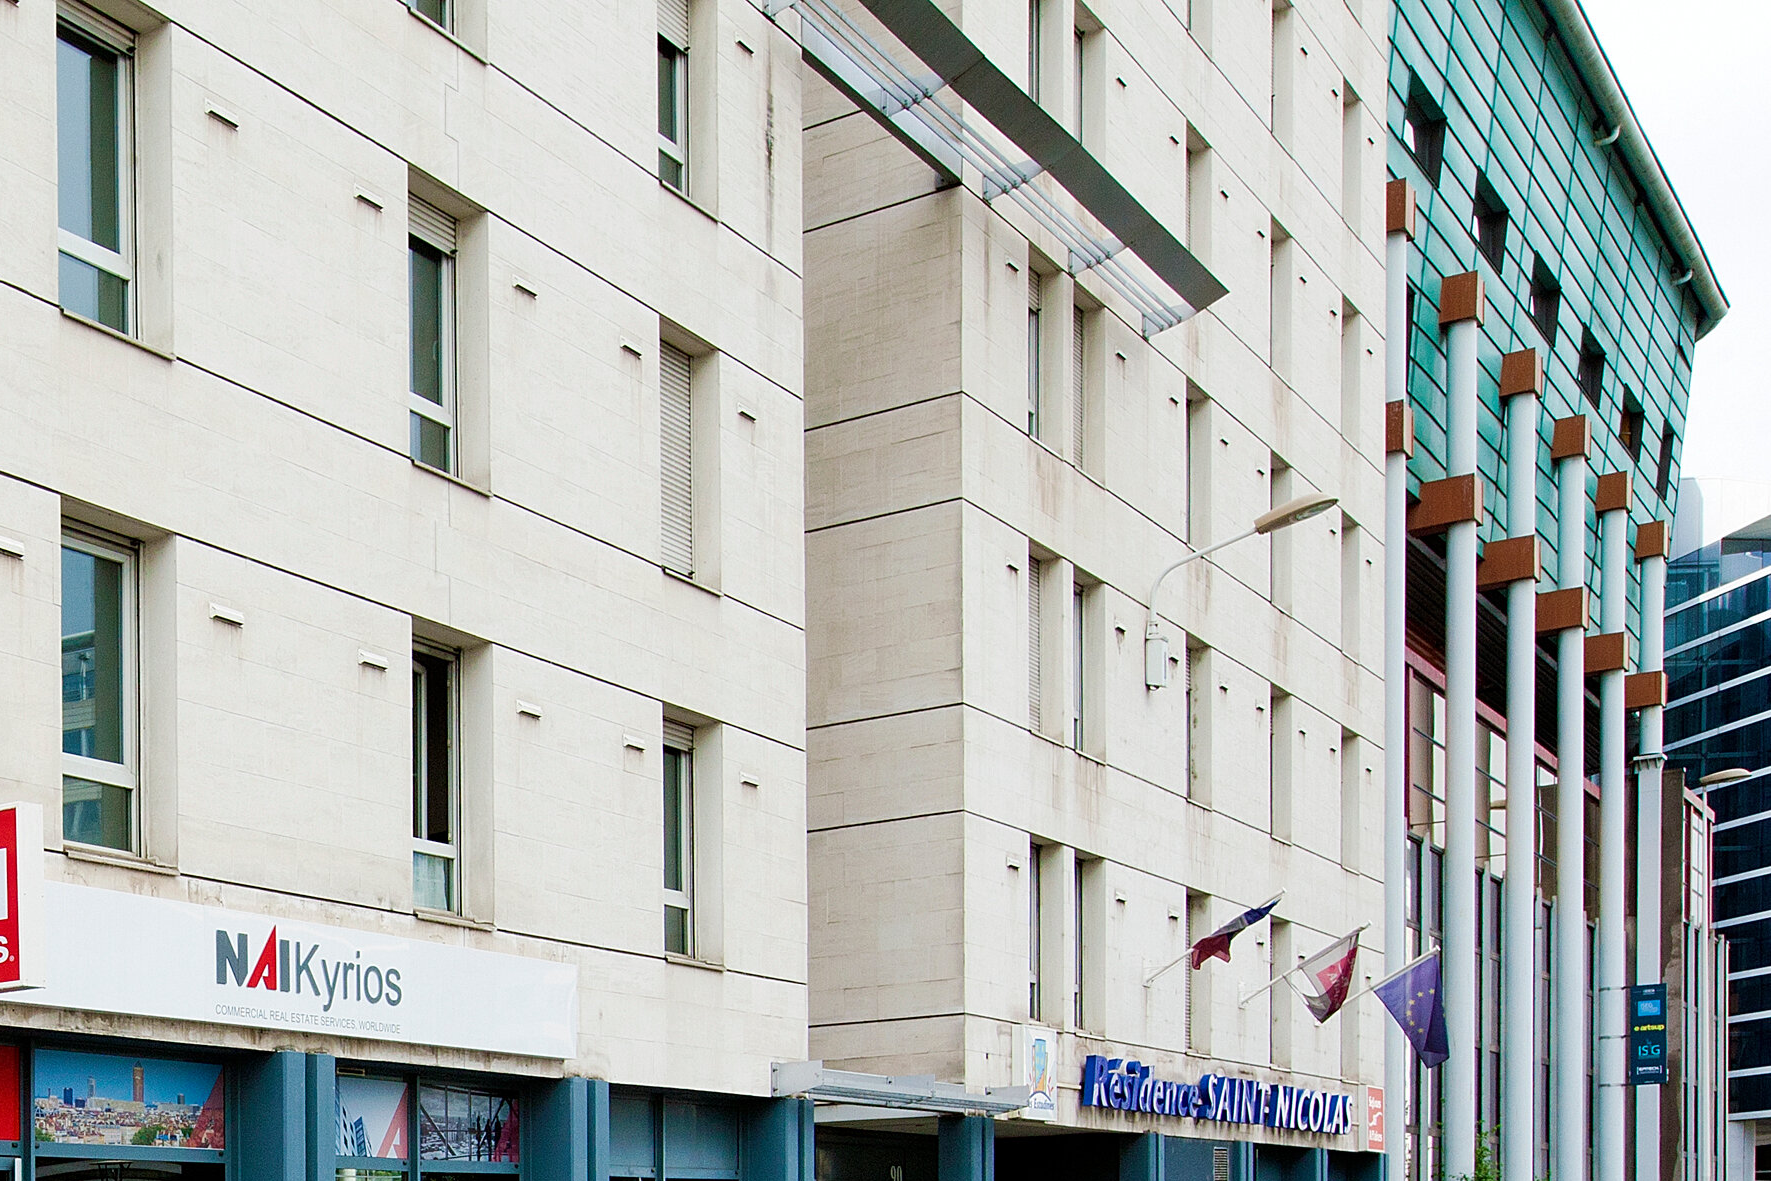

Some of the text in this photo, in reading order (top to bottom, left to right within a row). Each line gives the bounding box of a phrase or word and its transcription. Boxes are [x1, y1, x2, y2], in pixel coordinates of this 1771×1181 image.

[215, 1003, 268, 1020] COMMERCIAL
[269, 1010, 289, 1022] REAL
[290, 1012, 319, 1026] ESTATE
[358, 1020, 401, 1034] WORLDWIDE
[1083, 1054, 1201, 1118] Résidence
[1269, 1084, 1353, 1135] NICOLAS
